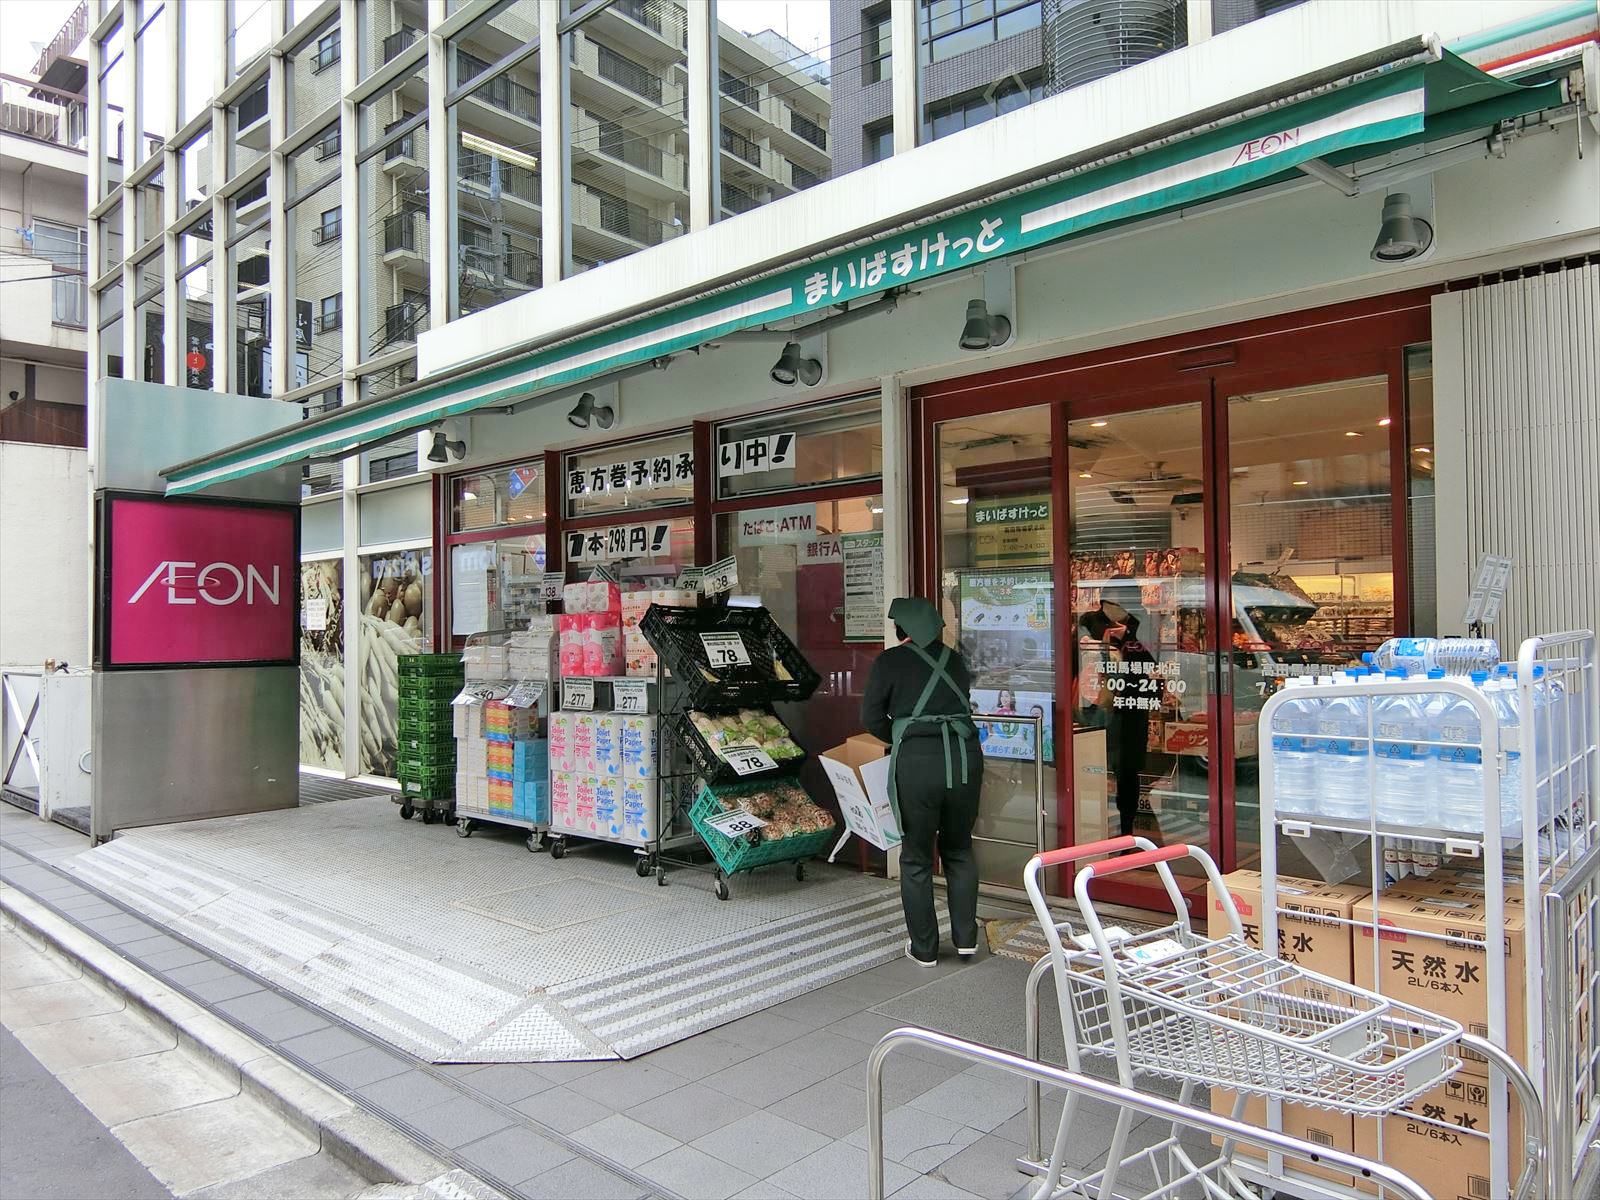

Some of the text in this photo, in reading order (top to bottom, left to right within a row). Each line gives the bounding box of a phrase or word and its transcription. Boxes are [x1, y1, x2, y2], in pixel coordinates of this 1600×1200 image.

[803, 216, 1005, 306] まいばすけっと
[569, 452, 694, 494] 恵方巻予約承
[975, 504, 1048, 523] まいばすけっと
[806, 541, 841, 558] 銀行A
[711, 574, 729, 592] 138
[545, 586, 557, 598] 138
[717, 649, 738, 663] 78
[1094, 661, 1181, 676] 高田馬場駅北店
[571, 693, 586, 706] 277
[622, 696, 638, 709] 277
[1112, 695, 1162, 710] 年中無休
[575, 726, 590, 735] Toilet
[596, 728, 611, 737] Toilet
[624, 729, 641, 738] Toilet
[575, 735, 592, 743] Paper
[596, 737, 612, 745] Paper
[624, 739, 643, 747] Paper
[740, 757, 764, 770] 78
[553, 781, 568, 791] Toilet
[577, 785, 593, 795] Toilet
[596, 787, 614, 797] Toilet
[553, 789, 569, 799] Paper
[576, 793, 594, 803] Paper
[624, 790, 642, 801] Toilet
[596, 796, 615, 805] Paper
[624, 800, 644, 810] Paper
[729, 820, 753, 832] 88
[1391, 949, 1480, 984] 天然水
[1407, 976, 1464, 996] 2L/6本入
[1406, 1123, 1463, 1147] 2L/6本入
